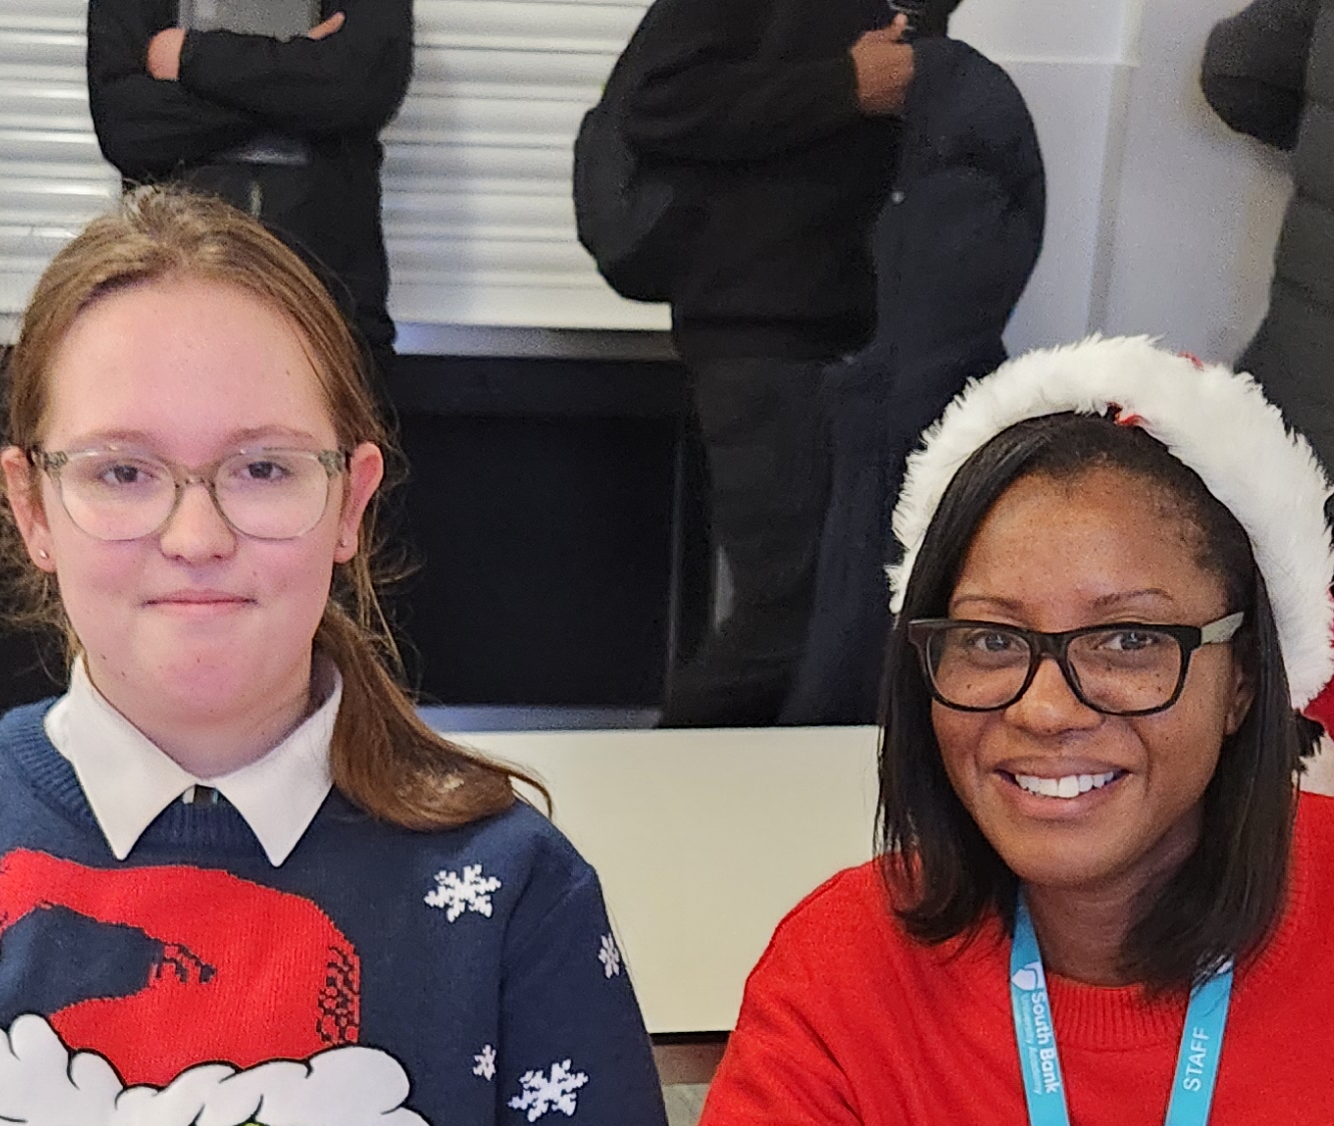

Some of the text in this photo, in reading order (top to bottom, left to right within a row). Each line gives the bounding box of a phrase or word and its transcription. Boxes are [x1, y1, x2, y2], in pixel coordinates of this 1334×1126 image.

[1031, 991, 1061, 1094] South Bank
[1183, 1026, 1211, 1093] STAFF
